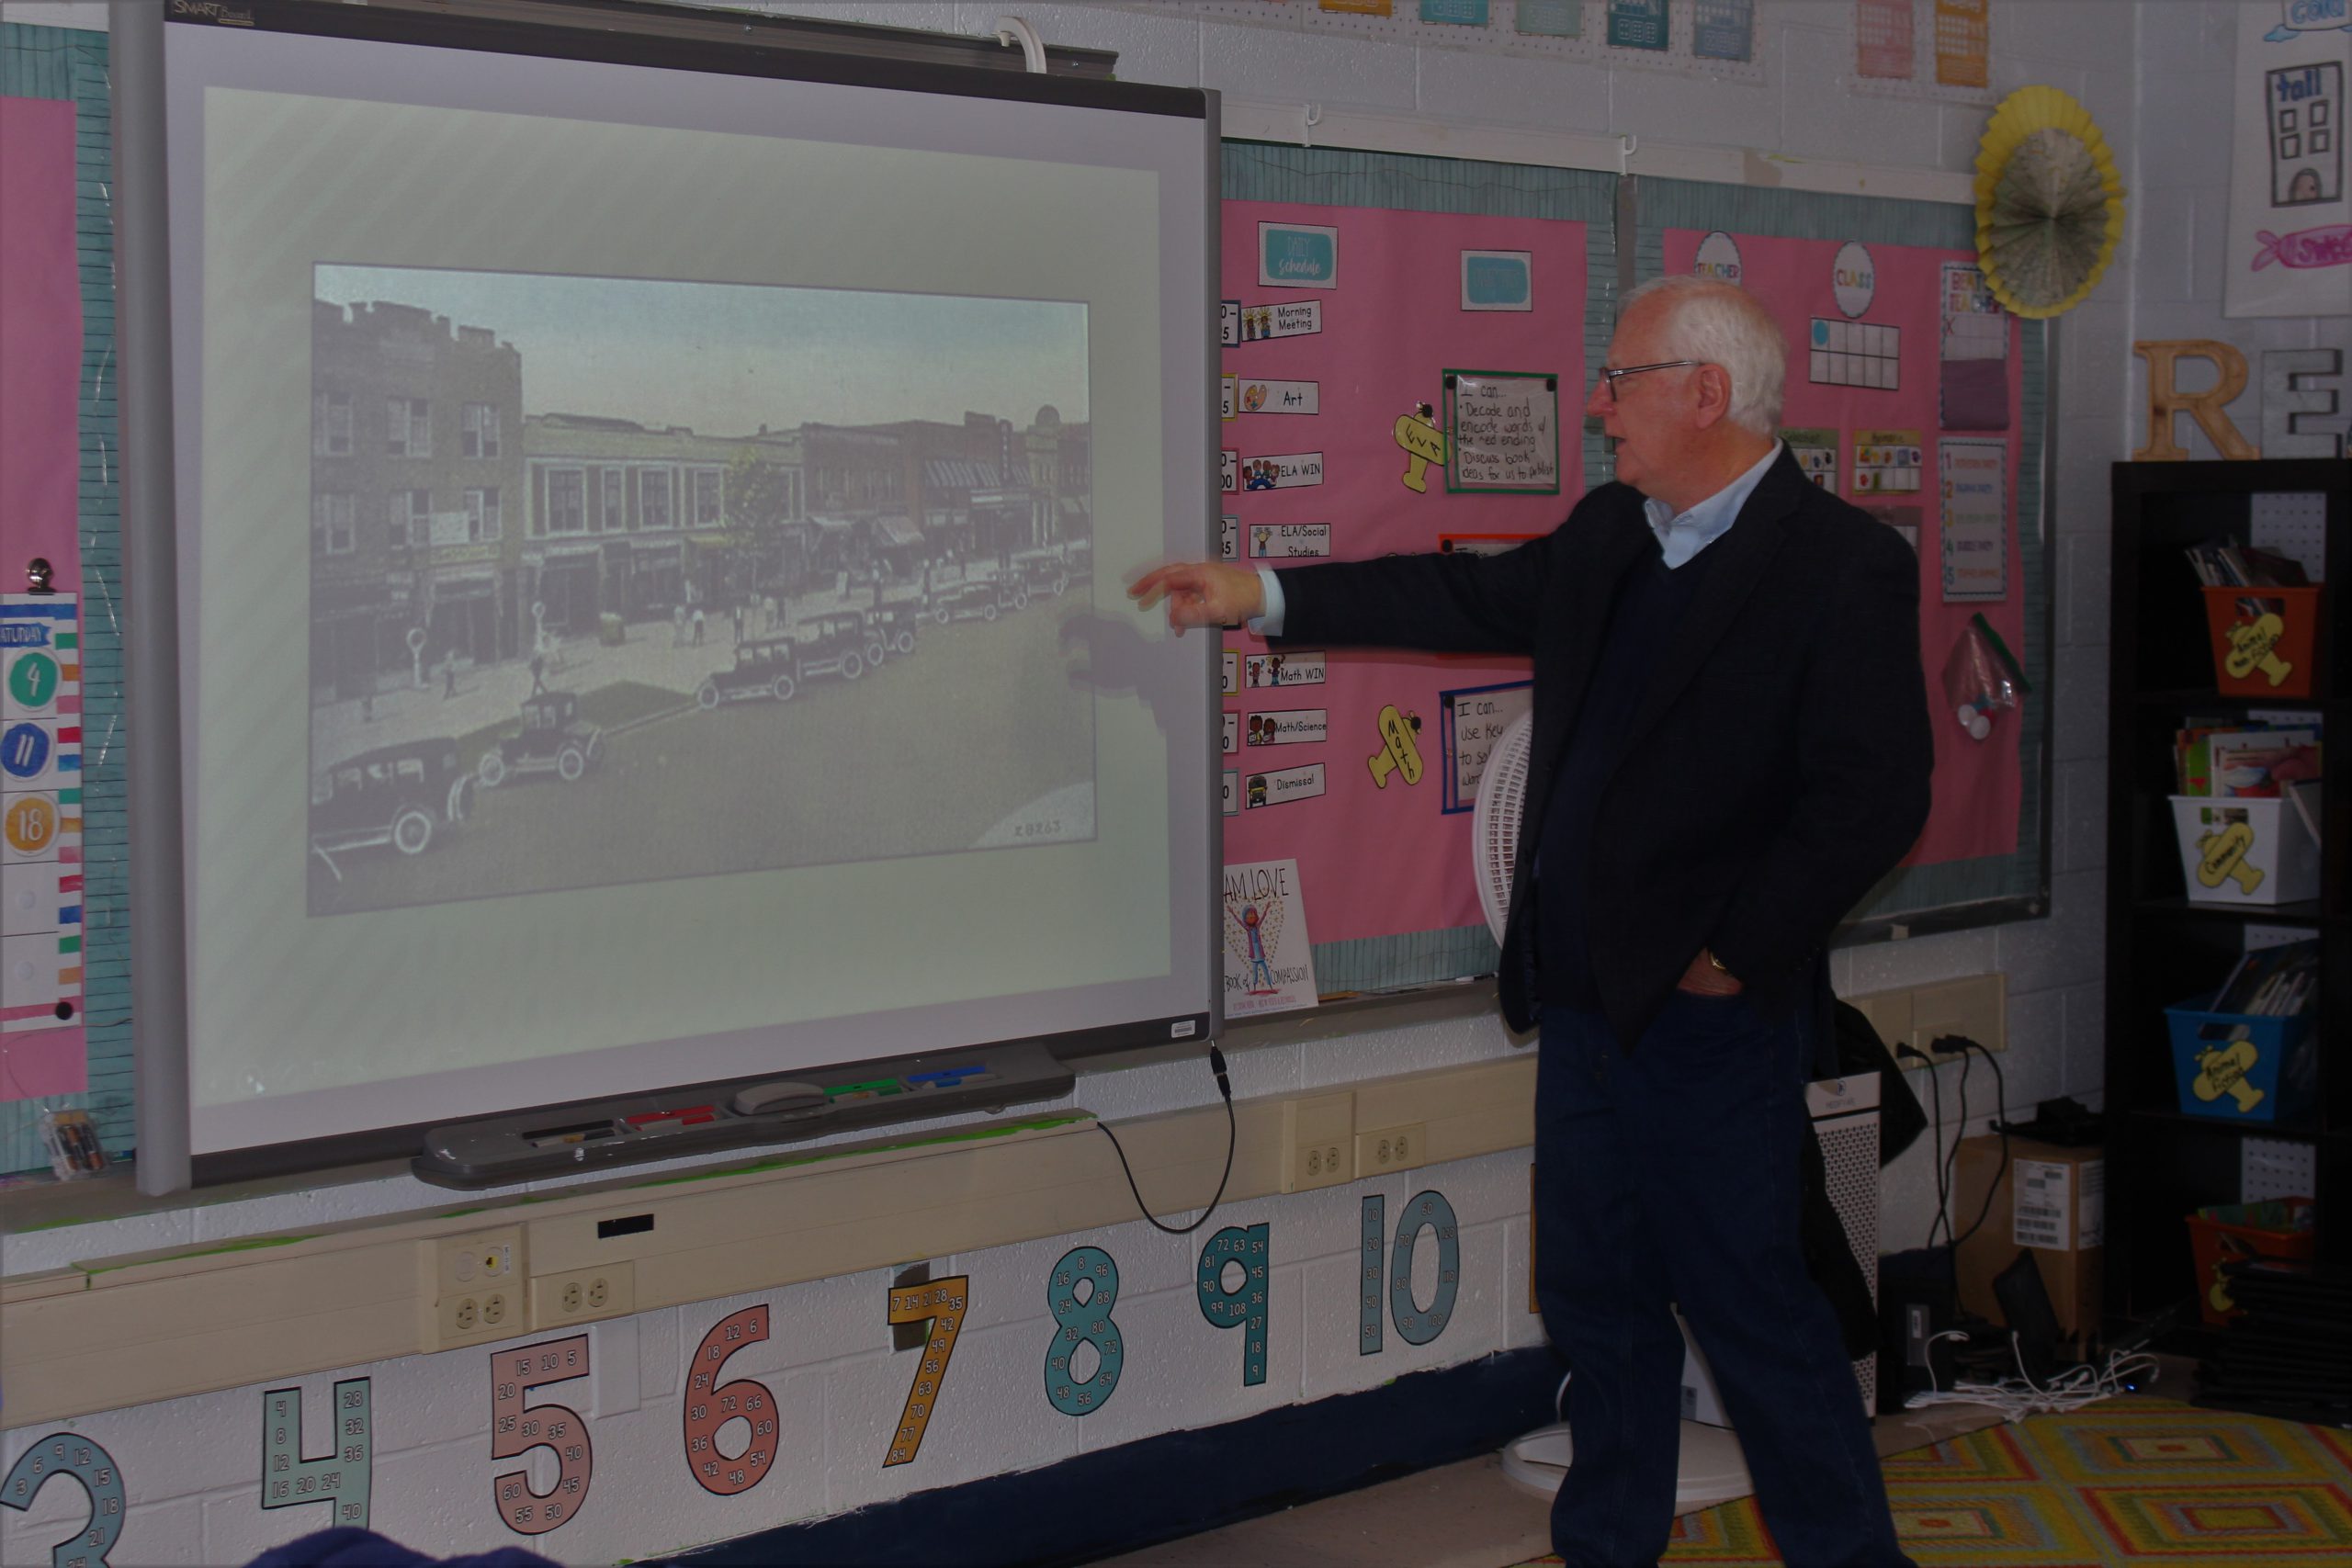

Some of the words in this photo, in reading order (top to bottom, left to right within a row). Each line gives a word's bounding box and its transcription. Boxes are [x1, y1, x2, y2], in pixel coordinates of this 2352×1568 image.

[175, 0, 220, 17] SMART
[2276, 68, 2322, 102] tall
[1278, 258, 1321, 276] Schedule
[1837, 268, 1872, 289] CLASS
[1278, 307, 1312, 318] Morning
[1279, 319, 1312, 331] Meeting
[1283, 391, 1303, 406] Art
[1465, 402, 1502, 417] Decode
[1507, 397, 1531, 418] and
[1461, 417, 1497, 434] encode
[1503, 417, 1532, 433] words
[1406, 423, 1442, 457] ELA
[1458, 434, 1474, 446] the
[1501, 436, 1535, 453] ending
[1464, 451, 1499, 465] Discuss
[1506, 449, 1529, 465] book
[1281, 466, 1297, 478] ELA
[1301, 463, 1320, 476] WIN
[1488, 466, 1499, 480] for
[1281, 525, 1327, 536] ELA/Social
[1288, 546, 1319, 558] Studies
[27, 660, 40, 697] 4
[1281, 670, 1302, 682] Math
[1305, 668, 1325, 680] WIN
[1457, 702, 1470, 717] I
[1274, 722, 1327, 733] Math/Science
[1461, 726, 1481, 741] use
[15, 733, 35, 767] 11
[1388, 719, 1415, 779] Math
[1459, 750, 1472, 766] to
[1277, 773, 1315, 791] Dismissal
[18, 808, 45, 841] 18
[1250, 868, 1289, 900] LOVE
[1224, 973, 1243, 993] BOOK
[1270, 964, 1309, 985] COMPASSION
[1368, 1209, 1378, 1222] 10
[1217, 1239, 1229, 1251] 72
[1234, 1239, 1246, 1252] 63
[1252, 1241, 1264, 1254] 54
[1367, 1238, 1379, 1251] 20
[1398, 1234, 1410, 1247] 70
[1078, 1258, 1085, 1269] 8
[1204, 1256, 1215, 1268] 81
[1096, 1264, 1108, 1277] 96
[1252, 1266, 1263, 1279] 45
[1359, 1190, 1460, 1357] 10
[1367, 1267, 1378, 1280] 30
[1057, 1272, 1070, 1286] 16
[1203, 1280, 1215, 1292] 90
[1396, 1278, 1407, 1291] 80
[892, 1298, 900, 1311] 7
[905, 1295, 919, 1310] 14
[923, 1293, 932, 1307] 21
[934, 1290, 947, 1303] 28
[949, 1297, 963, 1311] 35
[1097, 1291, 1110, 1305] 88
[1196, 1222, 1270, 1388] 9
[1251, 1292, 1262, 1304] 36
[1366, 1296, 1377, 1309] 40
[1059, 1299, 1072, 1314] 24
[1211, 1302, 1224, 1314] 99
[1228, 1303, 1247, 1316] 108
[726, 1325, 741, 1340] 12
[750, 1319, 757, 1334] 6
[941, 1317, 954, 1331] 42
[1091, 1321, 1104, 1334] 80
[1250, 1316, 1262, 1329] 27
[1403, 1317, 1414, 1329] 90
[1045, 1246, 1124, 1416] 8
[1066, 1327, 1078, 1341] 32
[1365, 1325, 1377, 1337] 50
[707, 1346, 720, 1360] 18
[932, 1339, 945, 1353] 49
[1104, 1340, 1117, 1355] 72
[1251, 1341, 1261, 1353] 18
[516, 1359, 531, 1376] 15
[542, 1354, 559, 1371] 10
[567, 1351, 576, 1365] 5
[882, 1274, 969, 1468] 7
[925, 1360, 939, 1373] 56
[1052, 1357, 1066, 1370] 40
[1252, 1365, 1259, 1377] 9
[695, 1372, 709, 1389] 24
[1100, 1372, 1113, 1386] 64
[498, 1383, 514, 1400] 20
[918, 1382, 932, 1396] 63
[1057, 1386, 1070, 1399] 48
[344, 1391, 362, 1408] 28
[684, 1303, 780, 1496] 6
[721, 1396, 737, 1413] 72
[746, 1395, 763, 1411] 66
[1078, 1393, 1091, 1405] 56
[276, 1400, 286, 1417] 4
[691, 1405, 707, 1420] 30
[911, 1404, 925, 1419] 70
[345, 1418, 364, 1436] 32
[490, 1333, 593, 1535] 5
[499, 1416, 515, 1432] 25
[522, 1420, 539, 1437] 30
[548, 1423, 566, 1439] 35
[756, 1420, 773, 1435] 60
[901, 1427, 915, 1442] 77
[276, 1428, 286, 1444] 8
[692, 1436, 707, 1451] 36
[55, 1443, 64, 1461] 9
[74, 1447, 90, 1466] 12
[262, 1376, 371, 1528] 4
[345, 1445, 363, 1462] 36
[566, 1445, 582, 1461] 40
[751, 1450, 766, 1467] 54
[891, 1448, 906, 1462] 84
[33, 1456, 43, 1474] 6
[274, 1454, 289, 1472] 12
[704, 1461, 719, 1477] 42
[95, 1468, 110, 1487] 15
[273, 1481, 289, 1498] 16
[296, 1477, 316, 1495] 20
[322, 1472, 341, 1491] 24
[729, 1470, 744, 1485] 48
[17, 1478, 27, 1495] 3
[503, 1483, 520, 1500] 60
[563, 1477, 580, 1494] 45
[102, 1496, 119, 1516] 18
[342, 1503, 361, 1520] 40
[515, 1506, 533, 1523] 55
[545, 1504, 561, 1520] 50
[88, 1527, 104, 1547] 21
